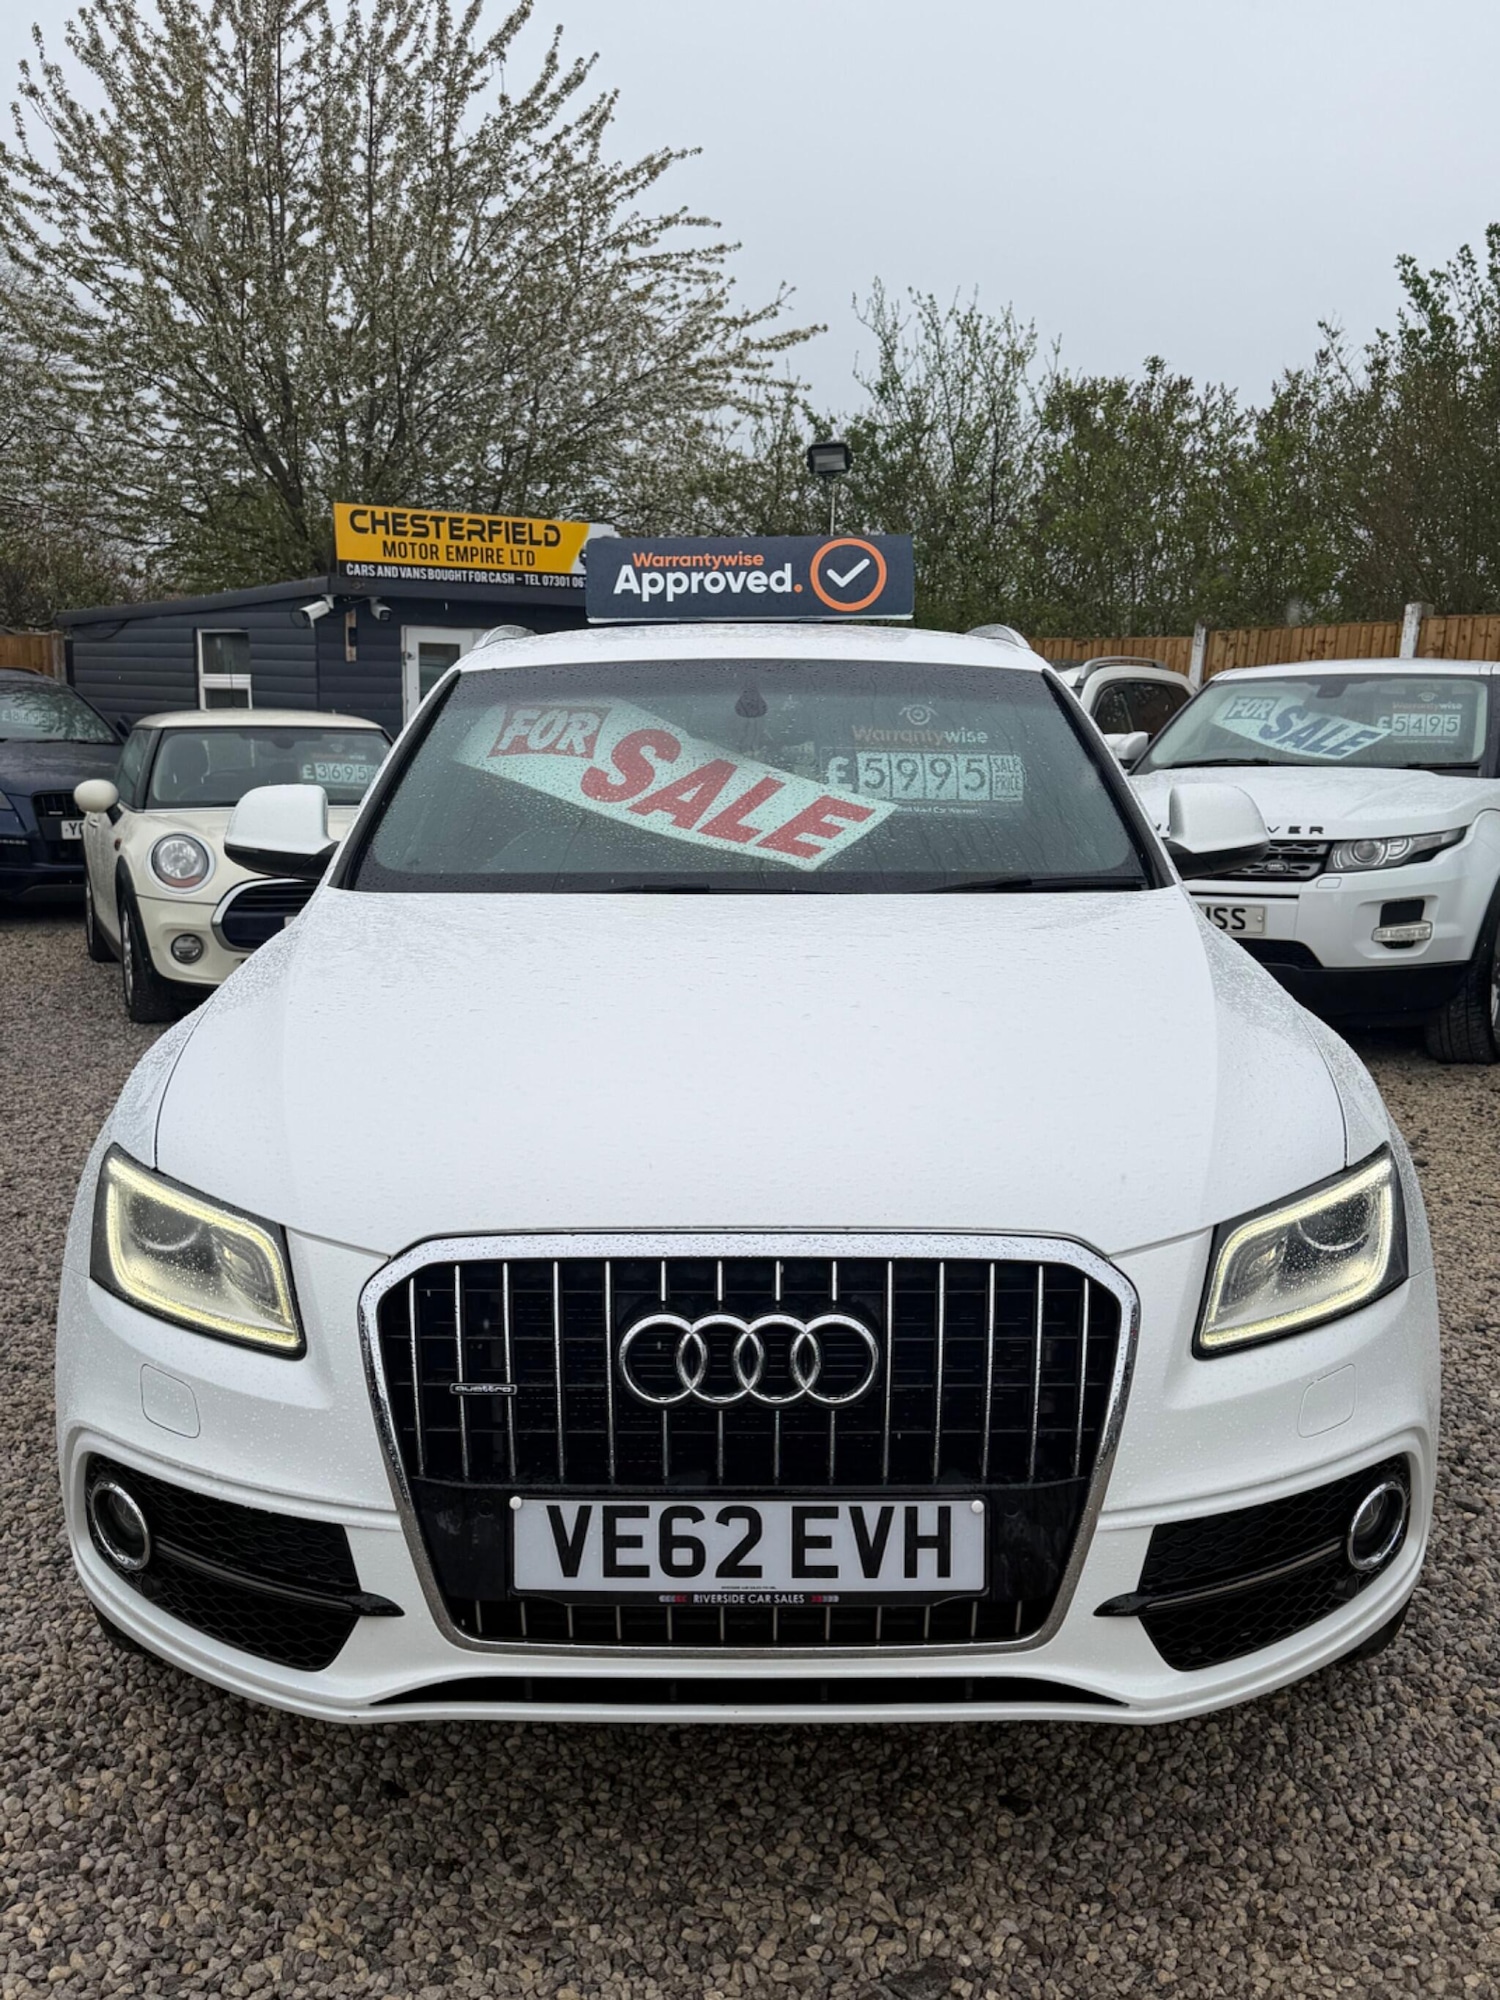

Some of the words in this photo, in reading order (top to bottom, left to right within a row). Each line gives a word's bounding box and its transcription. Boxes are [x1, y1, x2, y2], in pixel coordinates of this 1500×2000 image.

[349, 508, 561, 547] CHESTERFIELD
[382, 540, 440, 561] MOTOR
[446, 545, 505, 565] EMPIRE
[510, 549, 536, 567] LTD
[632, 551, 765, 571] Warrantywise
[346, 563, 375, 577] CARS
[376, 565, 399, 579] AND
[400, 567, 427, 580] VANS
[428, 569, 468, 583] BOUGHT
[468, 571, 488, 584] FOR
[488, 572, 515, 585] CASH
[524, 574, 540, 586] TEL
[542, 575, 570, 588] 07301
[572, 577, 586, 589] 06
[613, 563, 803, 602] Approved.
[852, 726, 989, 745] Warrantywise
[1229, 701, 1271, 719] FOR
[1259, 705, 1382, 756] SALE
[1377, 715, 1459, 733] £5495
[302, 764, 367, 780] £3695
[498, 707, 600, 756] FOR
[580, 728, 876, 860] SALE
[826, 756, 987, 793] £5995
[546, 1505, 762, 1579] VE62
[791, 1506, 951, 1579] EVH
[693, 1594, 746, 1604] RIVERSIDE
[747, 1594, 772, 1604] CAR
[775, 1594, 805, 1604] SALES
